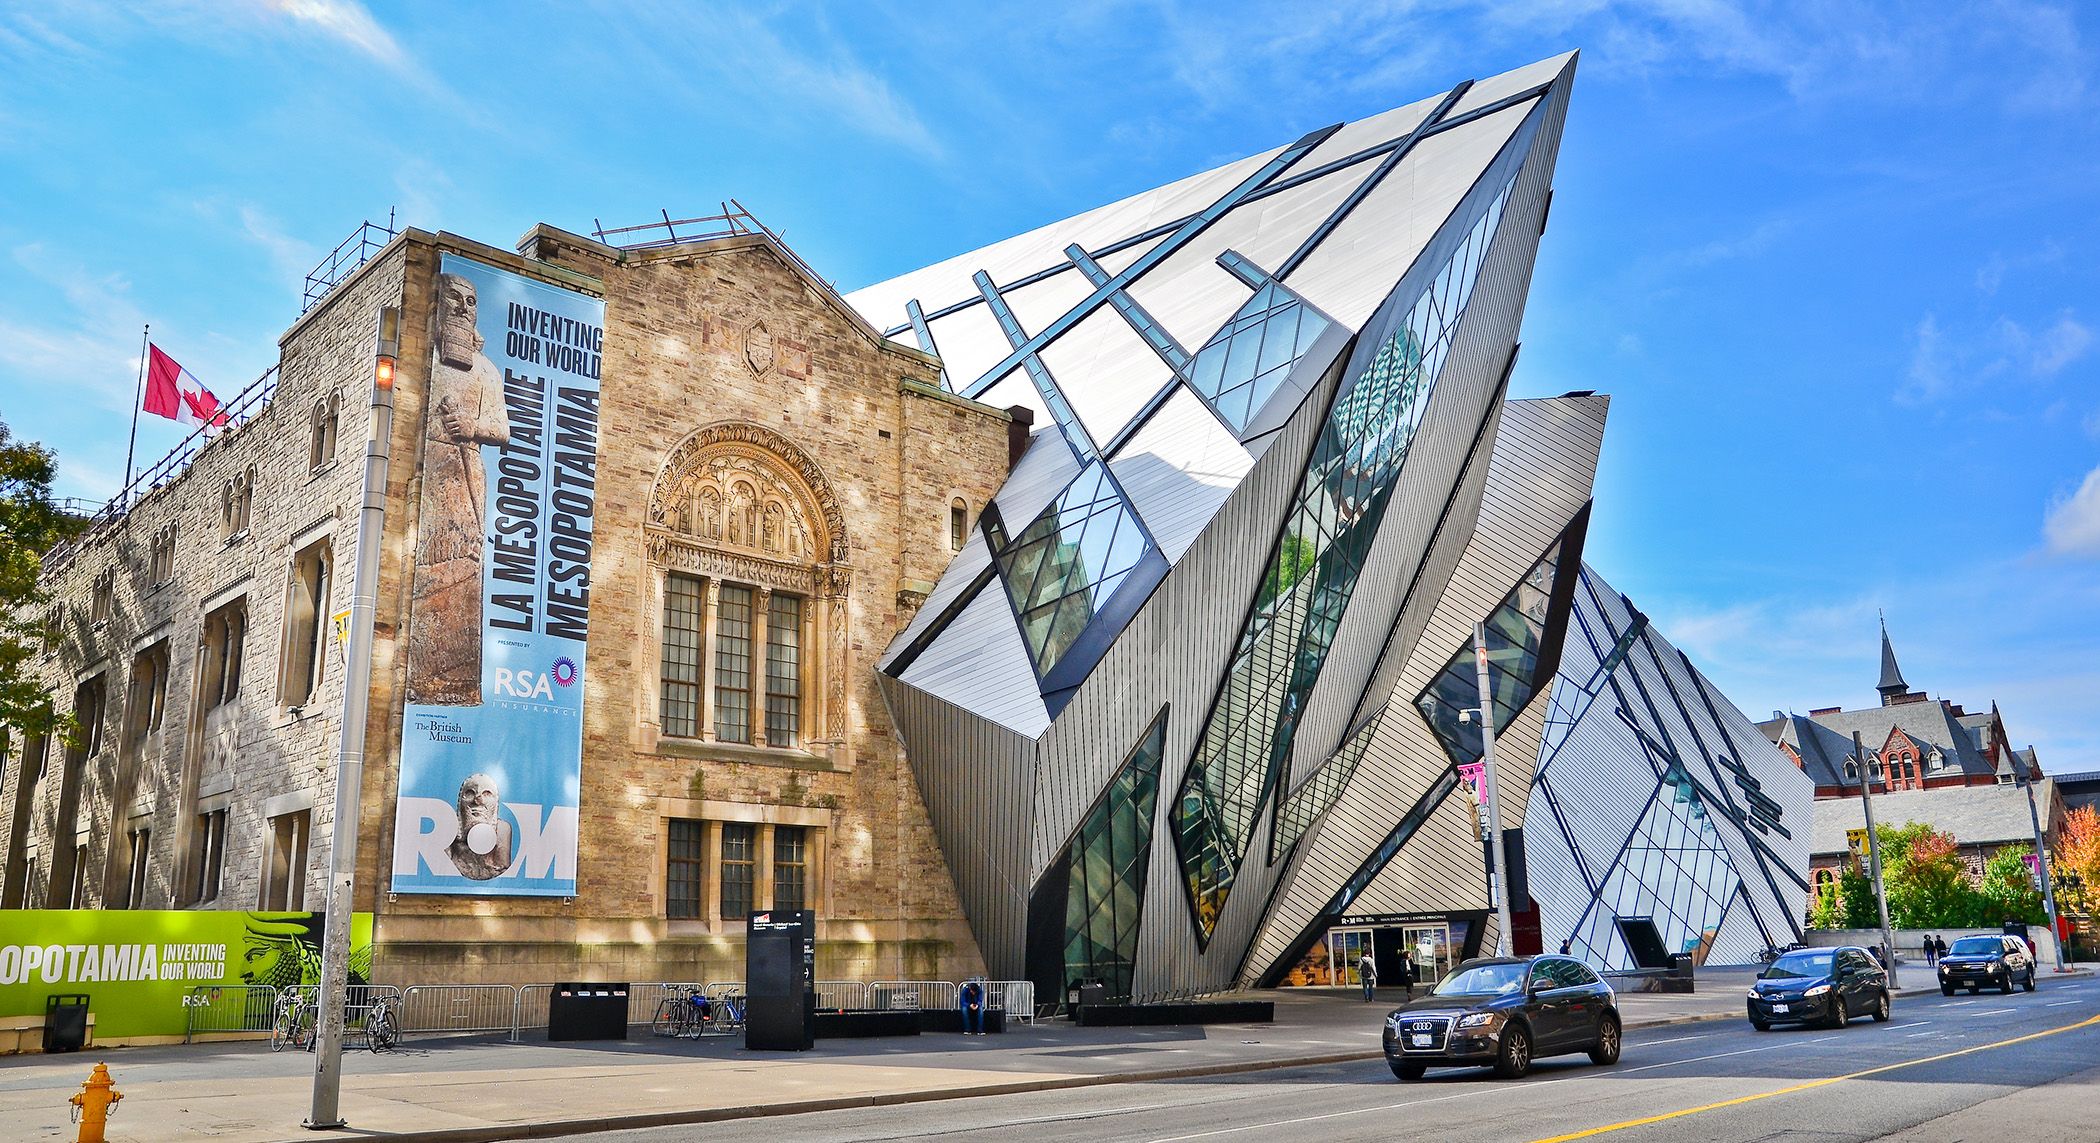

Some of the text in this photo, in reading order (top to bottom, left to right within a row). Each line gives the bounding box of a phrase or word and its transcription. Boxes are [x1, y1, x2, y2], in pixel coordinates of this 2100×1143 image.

[507, 302, 603, 354] INVENTING
[506, 331, 602, 381] OUR WORLD
[488, 368, 545, 633] LA MÉSOPOTAMIE
[546, 385, 600, 641] MESOPOTAMIA
[497, 640, 523, 648] PRESENTED
[494, 667, 554, 701] RSA
[492, 701, 577, 717] INSURANCE
[415, 721, 462, 733] The British
[429, 731, 472, 744] Museum
[163, 943, 226, 961] INVENTING
[160, 962, 225, 980] OUR WORLD
[182, 995, 210, 1007] RSA
